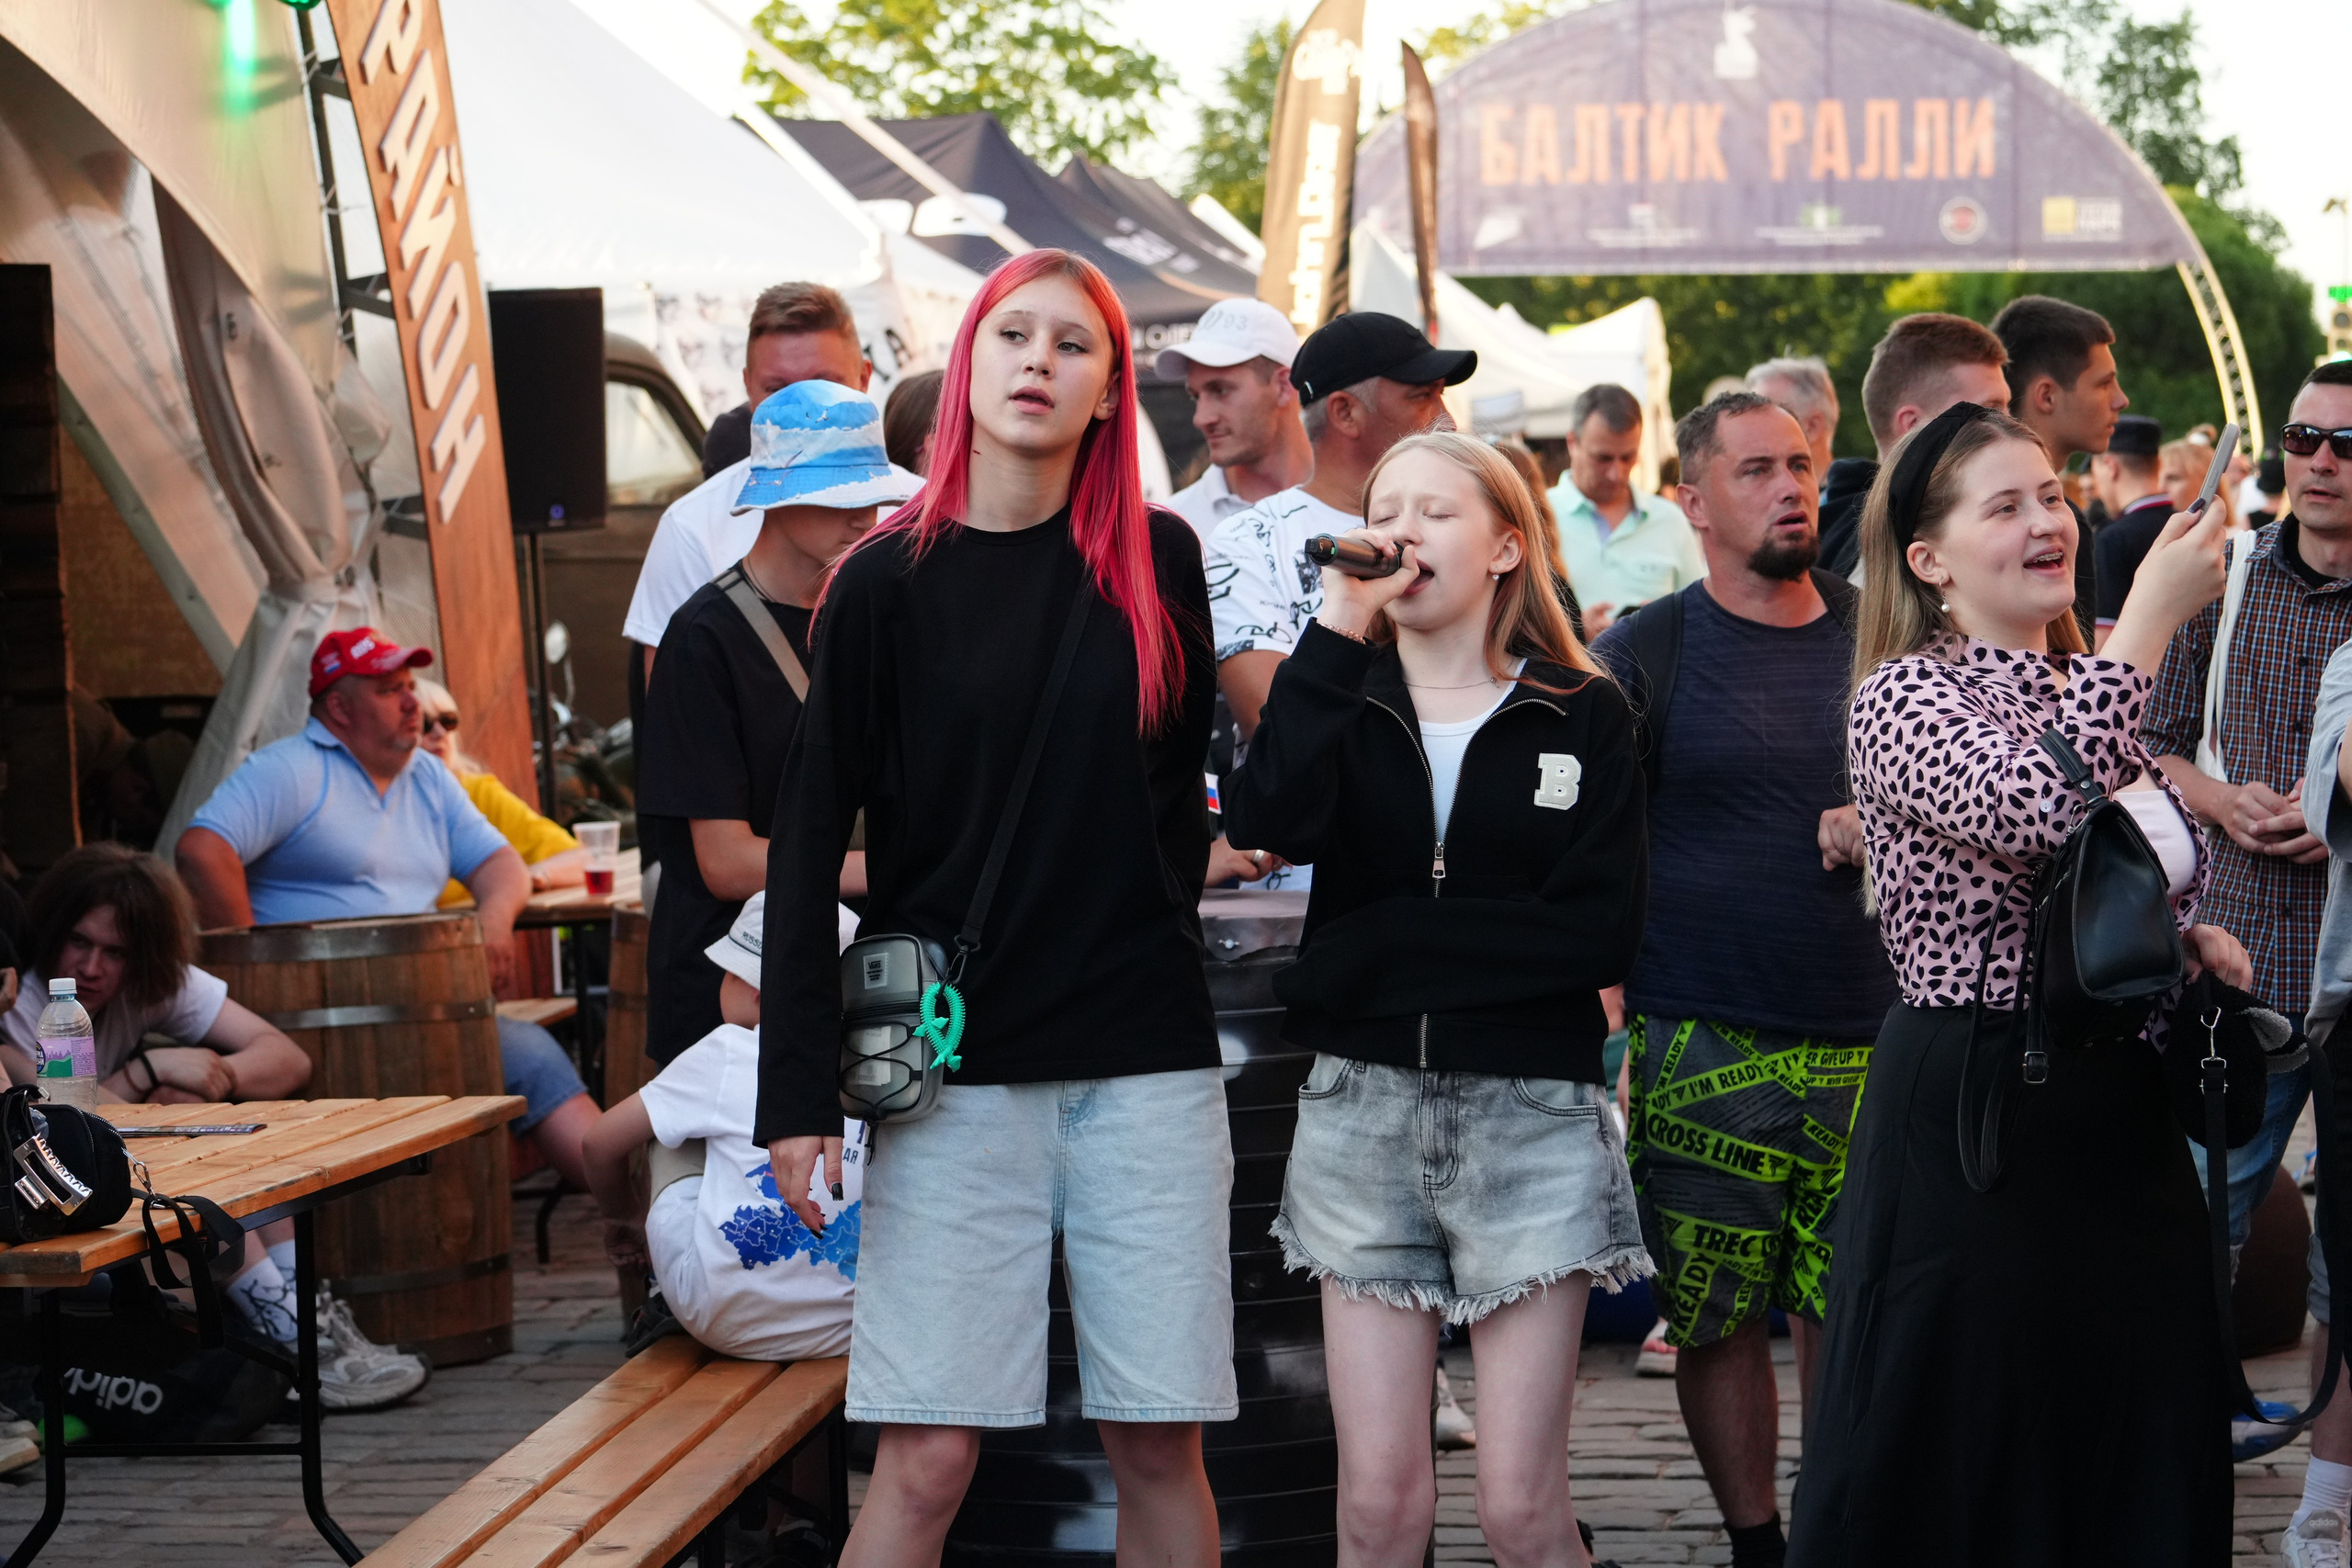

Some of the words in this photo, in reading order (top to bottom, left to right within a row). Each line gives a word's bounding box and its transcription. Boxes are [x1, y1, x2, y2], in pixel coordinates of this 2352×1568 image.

[1480, 102, 1729, 186] БАЛТИК
[1767, 98, 1996, 181] РАЛЛИ
[1533, 752, 1582, 810] B
[868, 960, 882, 970] VANS
[1662, 1038, 1684, 1075] READY
[1729, 1035, 1756, 1056] READY
[1839, 1050, 1854, 1065] UP
[1688, 1077, 1715, 1099] I'M
[1778, 1074, 1804, 1093] READY
[1647, 1112, 1709, 1156] CROSS
[1711, 1136, 1766, 1175] LINE
[1807, 1124, 1840, 1149] READY
[1692, 1224, 1758, 1258] TREC
[63, 1367, 164, 1415] adid
